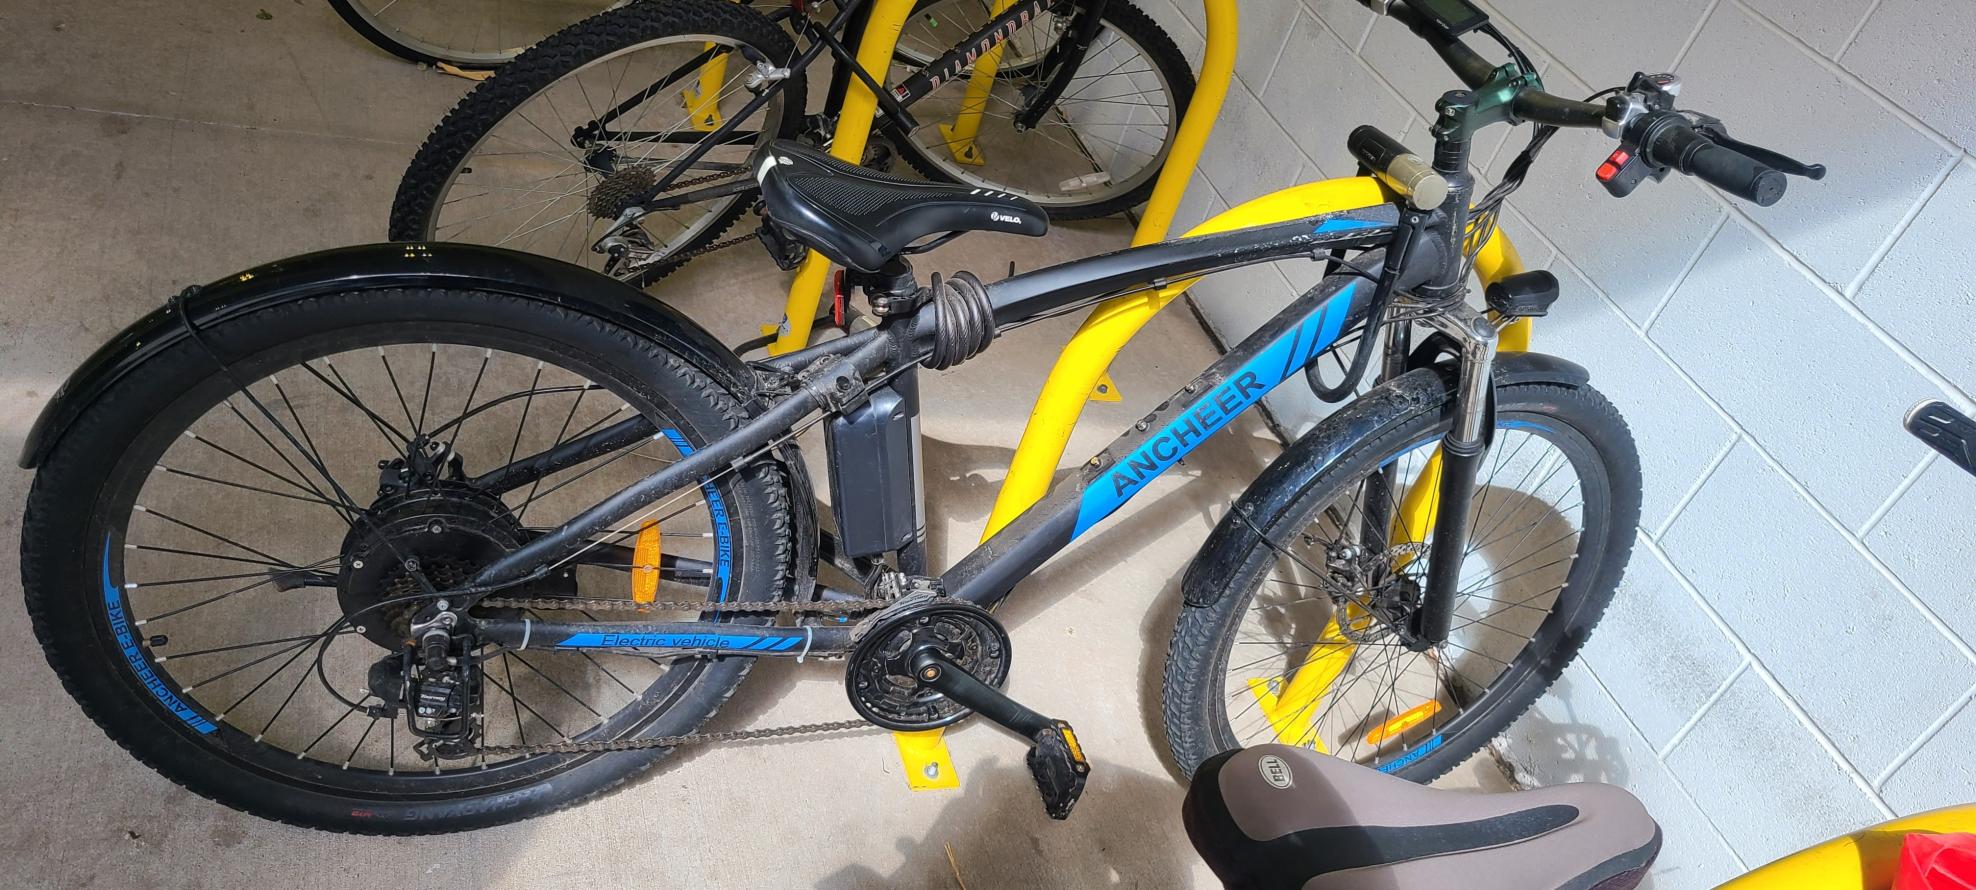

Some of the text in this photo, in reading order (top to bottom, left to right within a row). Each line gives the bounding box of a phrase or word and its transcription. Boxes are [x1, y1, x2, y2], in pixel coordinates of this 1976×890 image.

[999, 214, 1021, 224] VELO
[1110, 370, 1266, 498] ANCHEER
[718, 522, 730, 568] E-BIKE
[108, 600, 188, 713] ANCHEER E-BIKE
[600, 633, 730, 649] Electric vehicle
[1266, 758, 1286, 782] BELL
